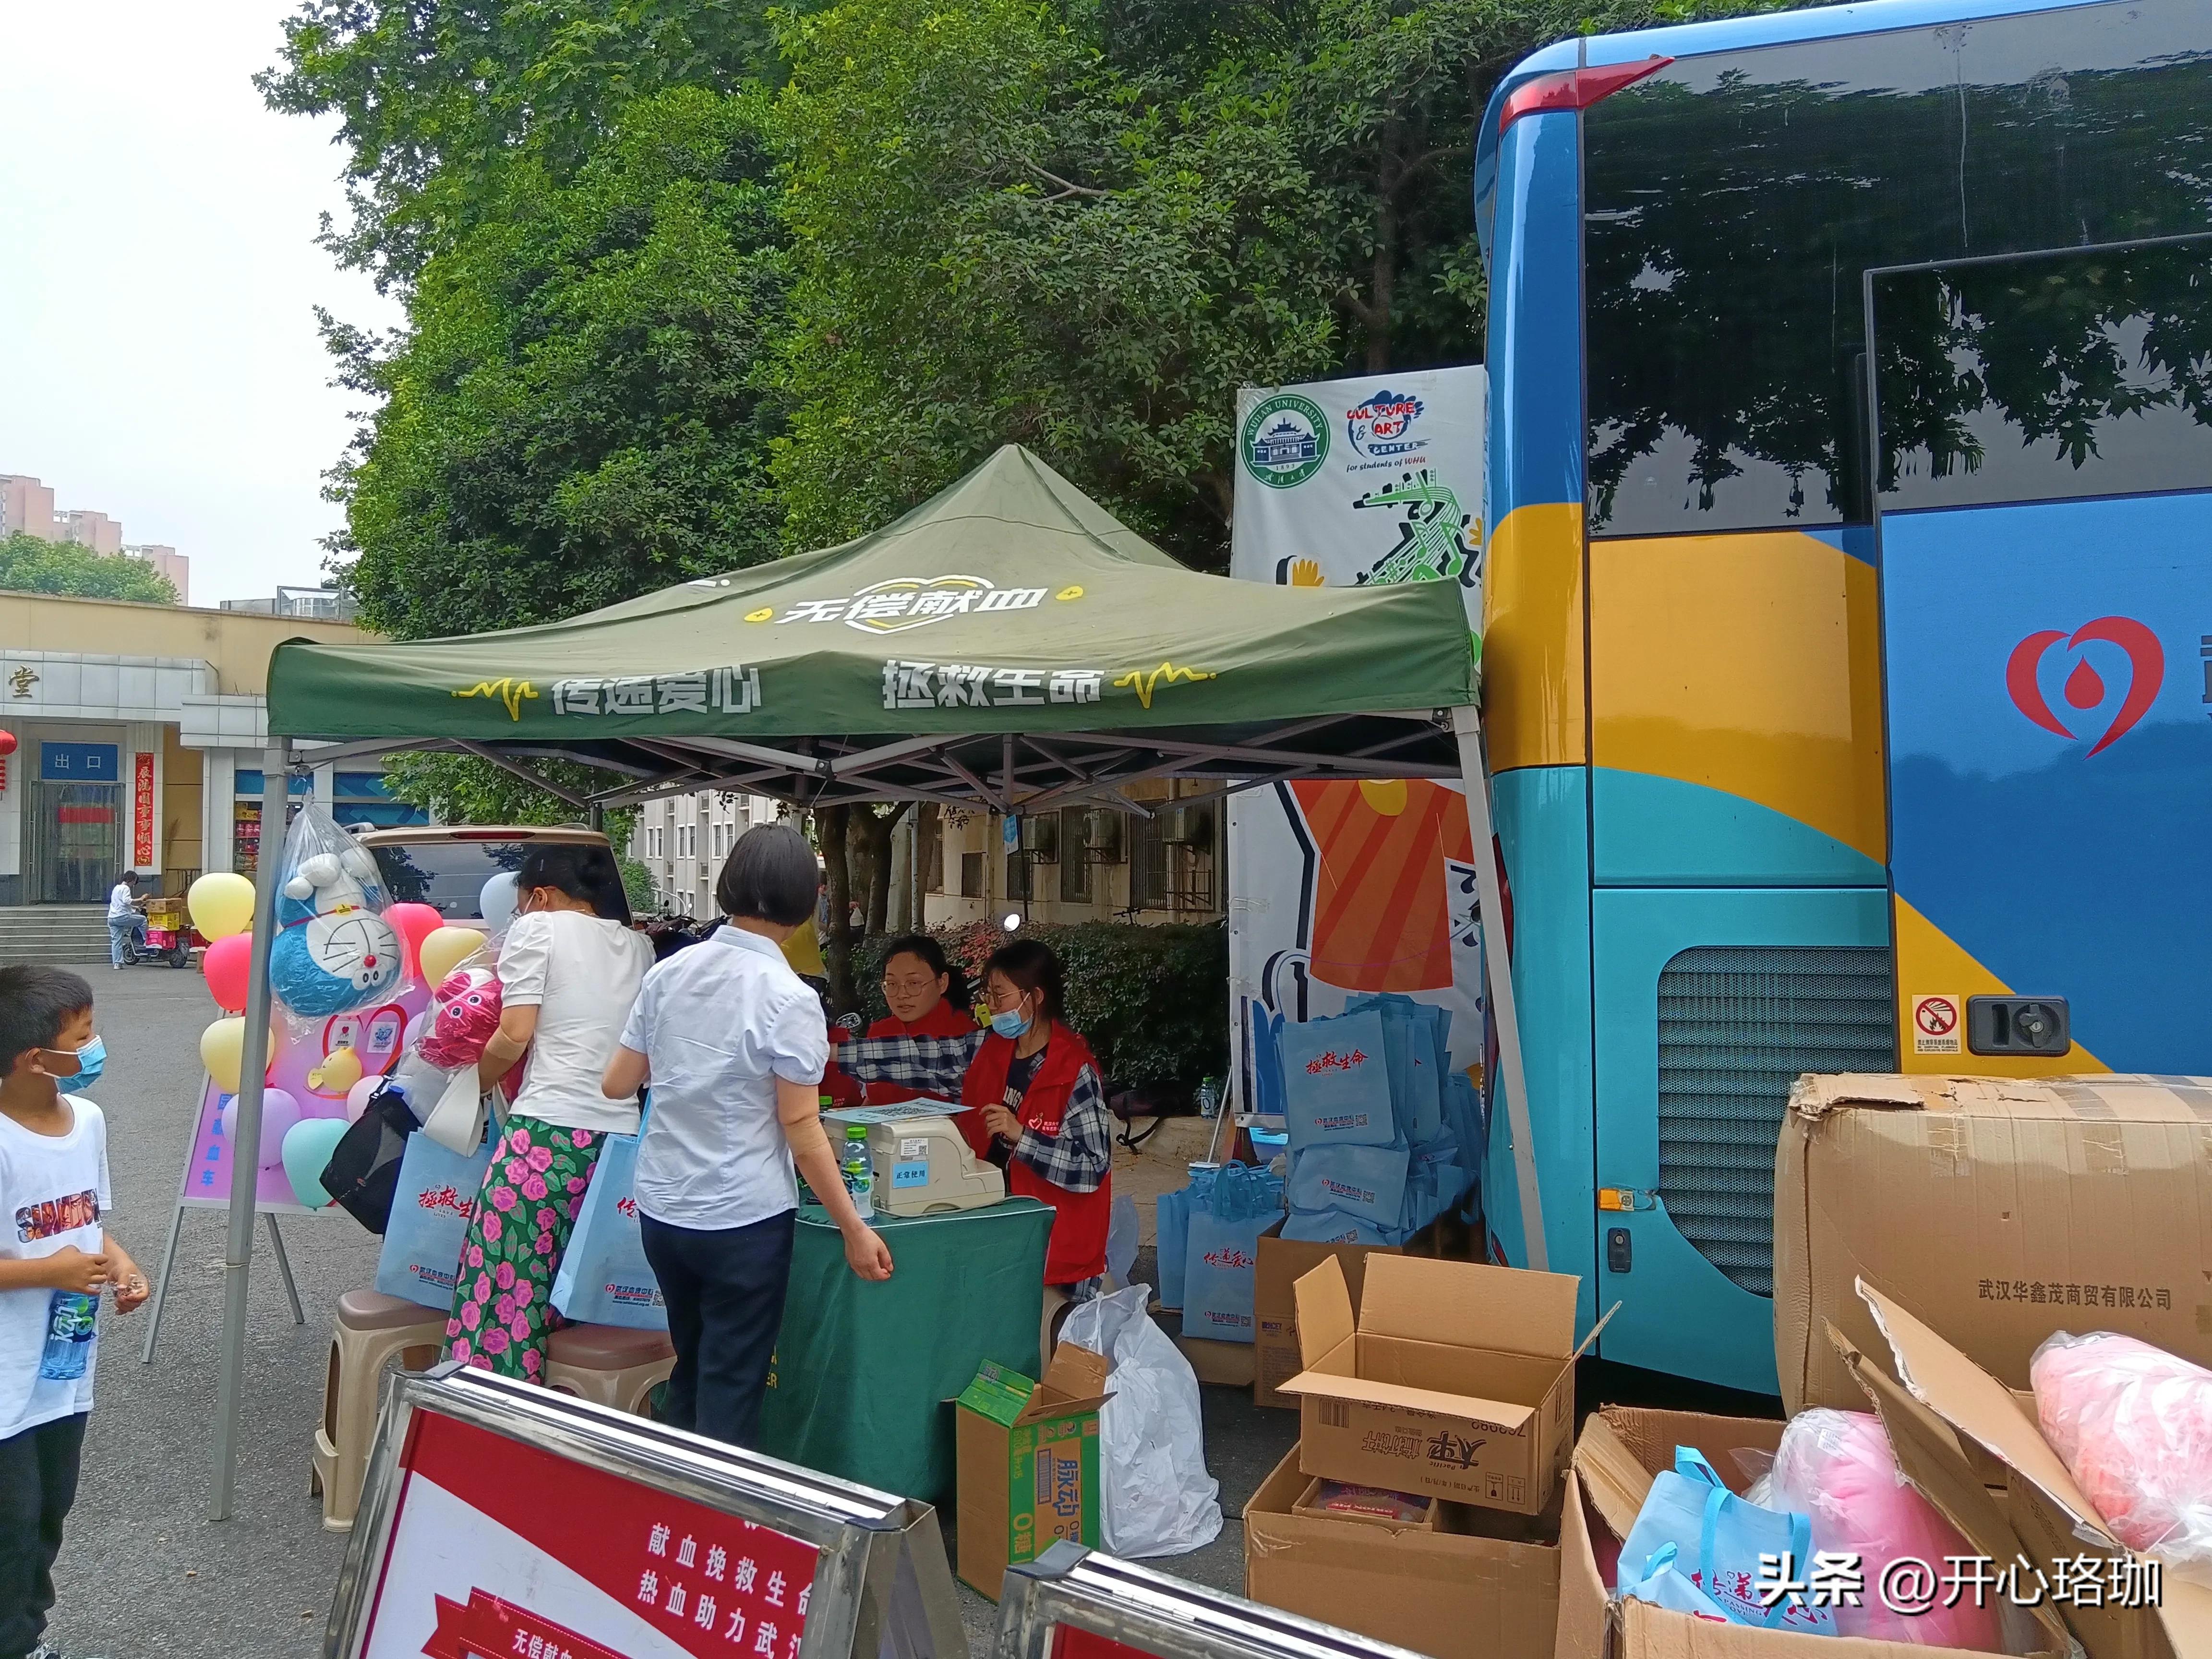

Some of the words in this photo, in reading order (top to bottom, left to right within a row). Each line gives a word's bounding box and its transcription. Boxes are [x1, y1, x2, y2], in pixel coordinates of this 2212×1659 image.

[1248, 405, 1272, 436] WUHAN
[1275, 399, 1323, 429] UNIVERSITY
[1346, 402, 1415, 420] CULTURE
[1374, 421, 1405, 434] ART
[1346, 464, 1358, 472] for
[1359, 460, 1392, 470] students
[1395, 458, 1402, 467] of
[1404, 456, 1426, 465] WHU
[1373, 443, 1417, 454] CENTER
[774, 588, 1048, 624] 无偿献血
[8, 665, 40, 698] 堂
[551, 664, 762, 715] 传递爱心
[882, 658, 1106, 710] 拯救生命
[55, 753, 101, 769] 出口
[1306, 1049, 1369, 1075] 拯救生命
[896, 1169, 926, 1180] 正常使用
[1203, 1247, 1254, 1269] 传递爱心
[1978, 1278, 2172, 1310] 武汉华鑫茂商贸有限公司
[1426, 1431, 1487, 1470] 太平
[1052, 1457, 1080, 1517] 脉动
[637, 1569, 802, 1659] 热血助力武
